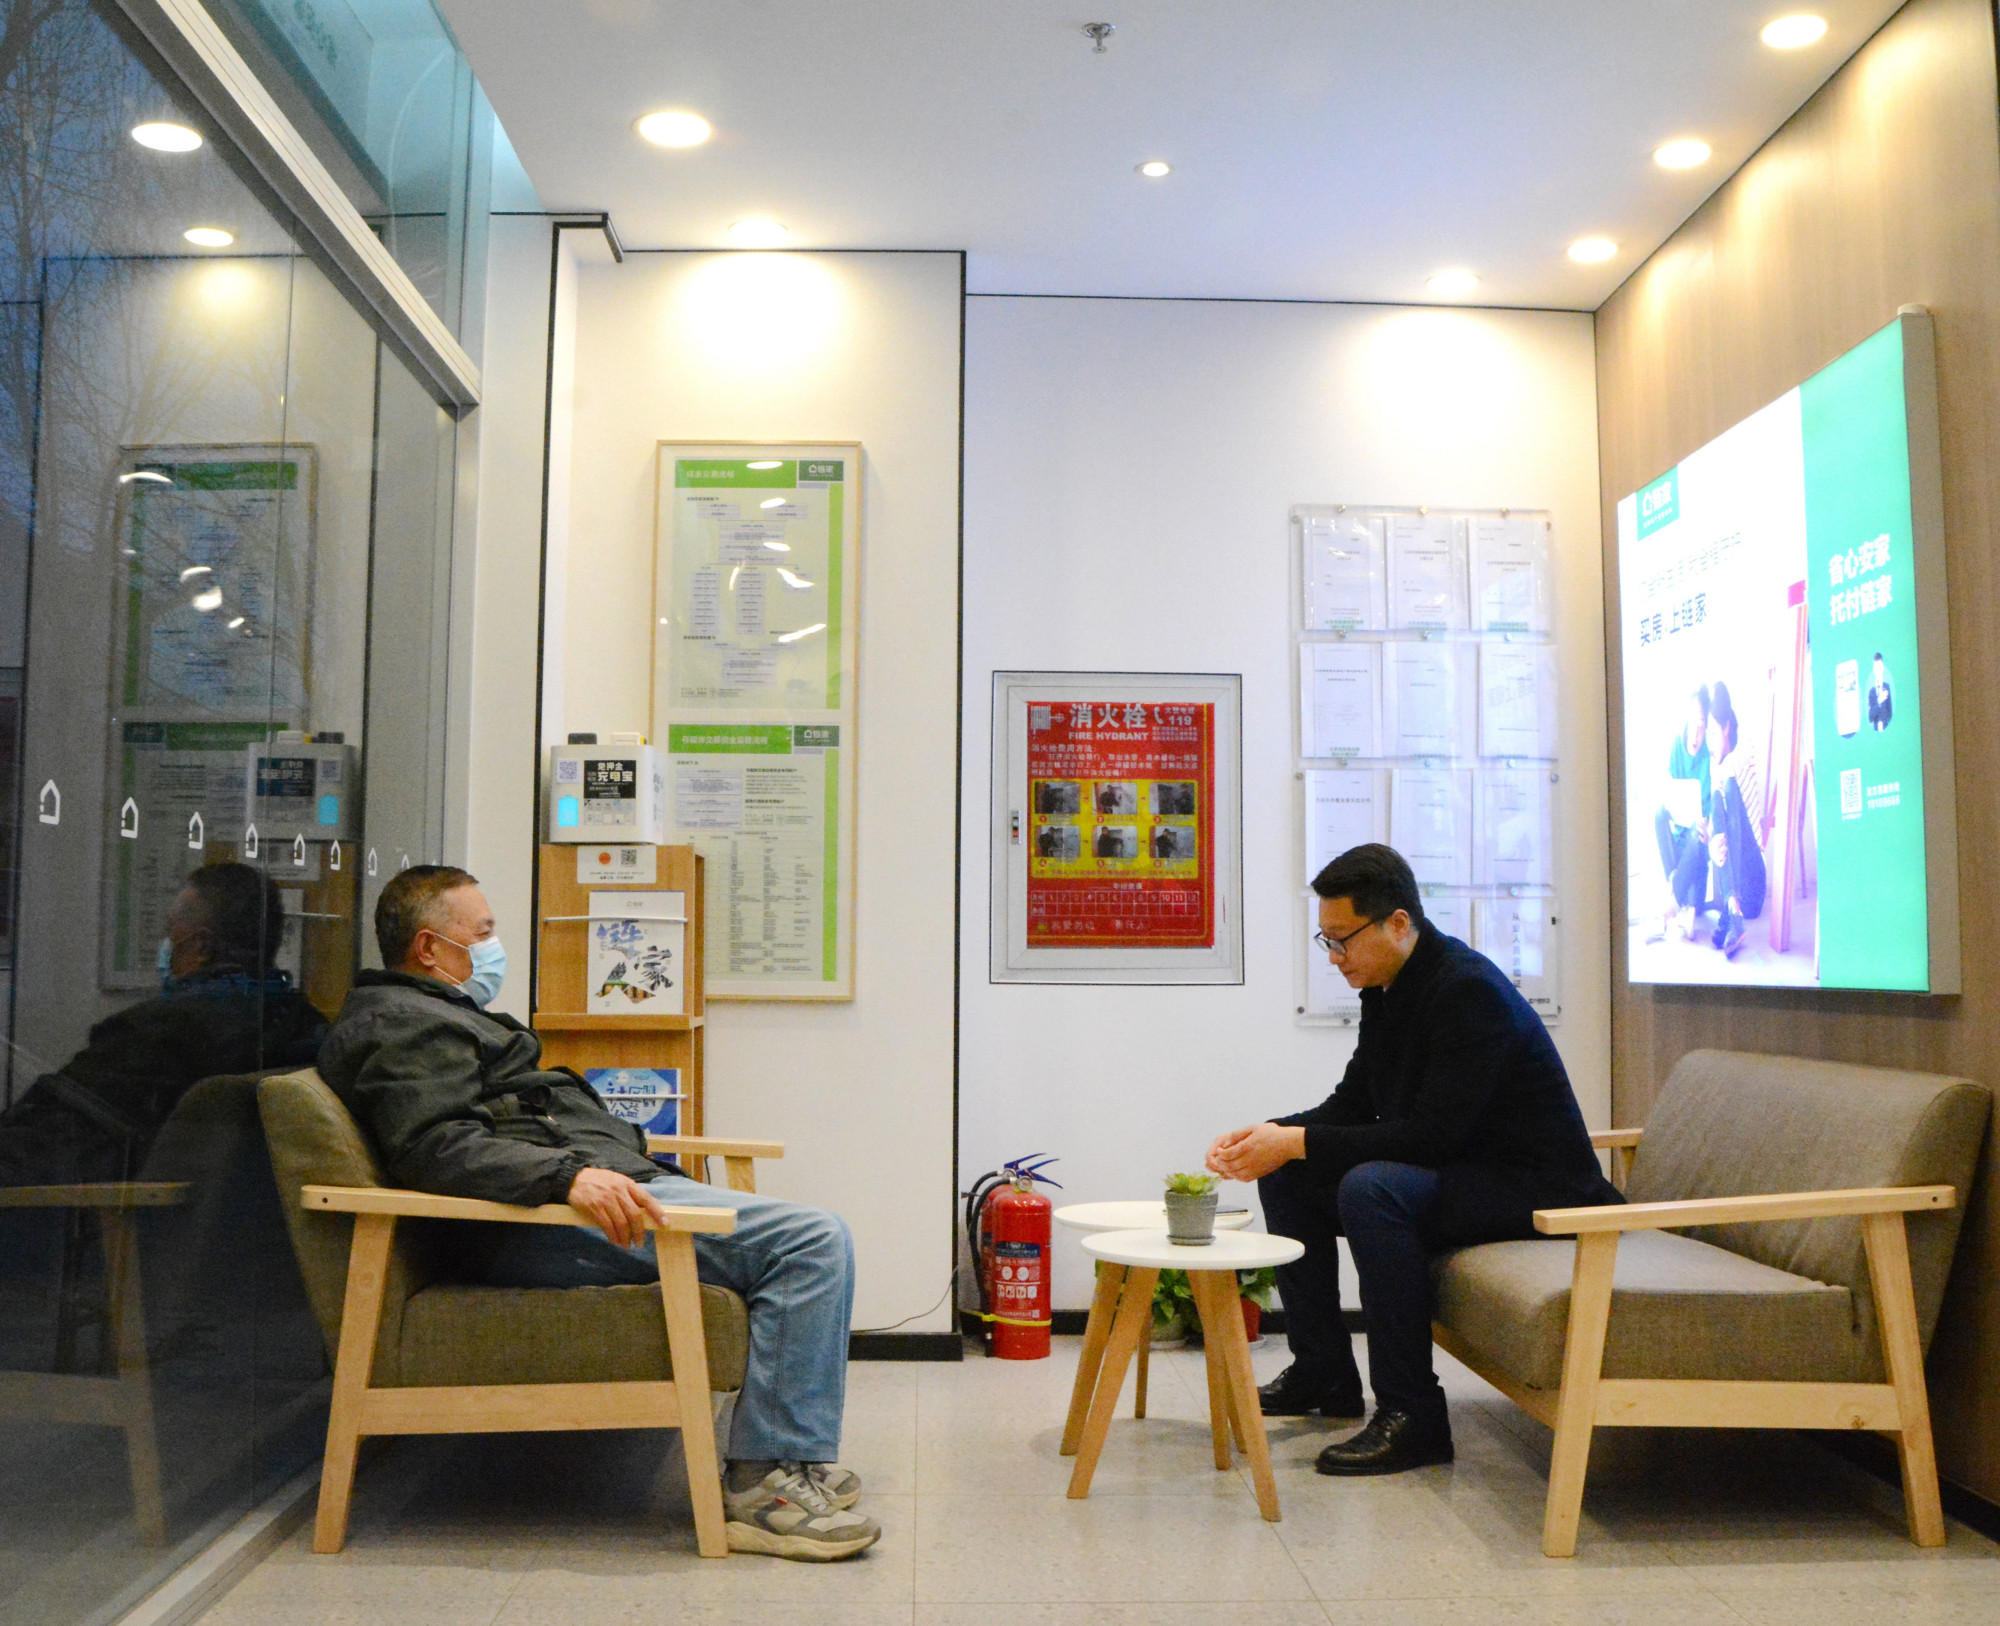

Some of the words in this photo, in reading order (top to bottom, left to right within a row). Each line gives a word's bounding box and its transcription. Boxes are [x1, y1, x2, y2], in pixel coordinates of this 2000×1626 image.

[1828, 533, 1891, 587] 省心安家
[1830, 574, 1893, 627] 托付链家
[1069, 703, 1147, 729] 消火栓
[1168, 715, 1193, 726] 119
[1068, 732, 1093, 741] FIRE
[1096, 732, 1149, 741] HYDRANT
[597, 771, 634, 782] 充电宝
